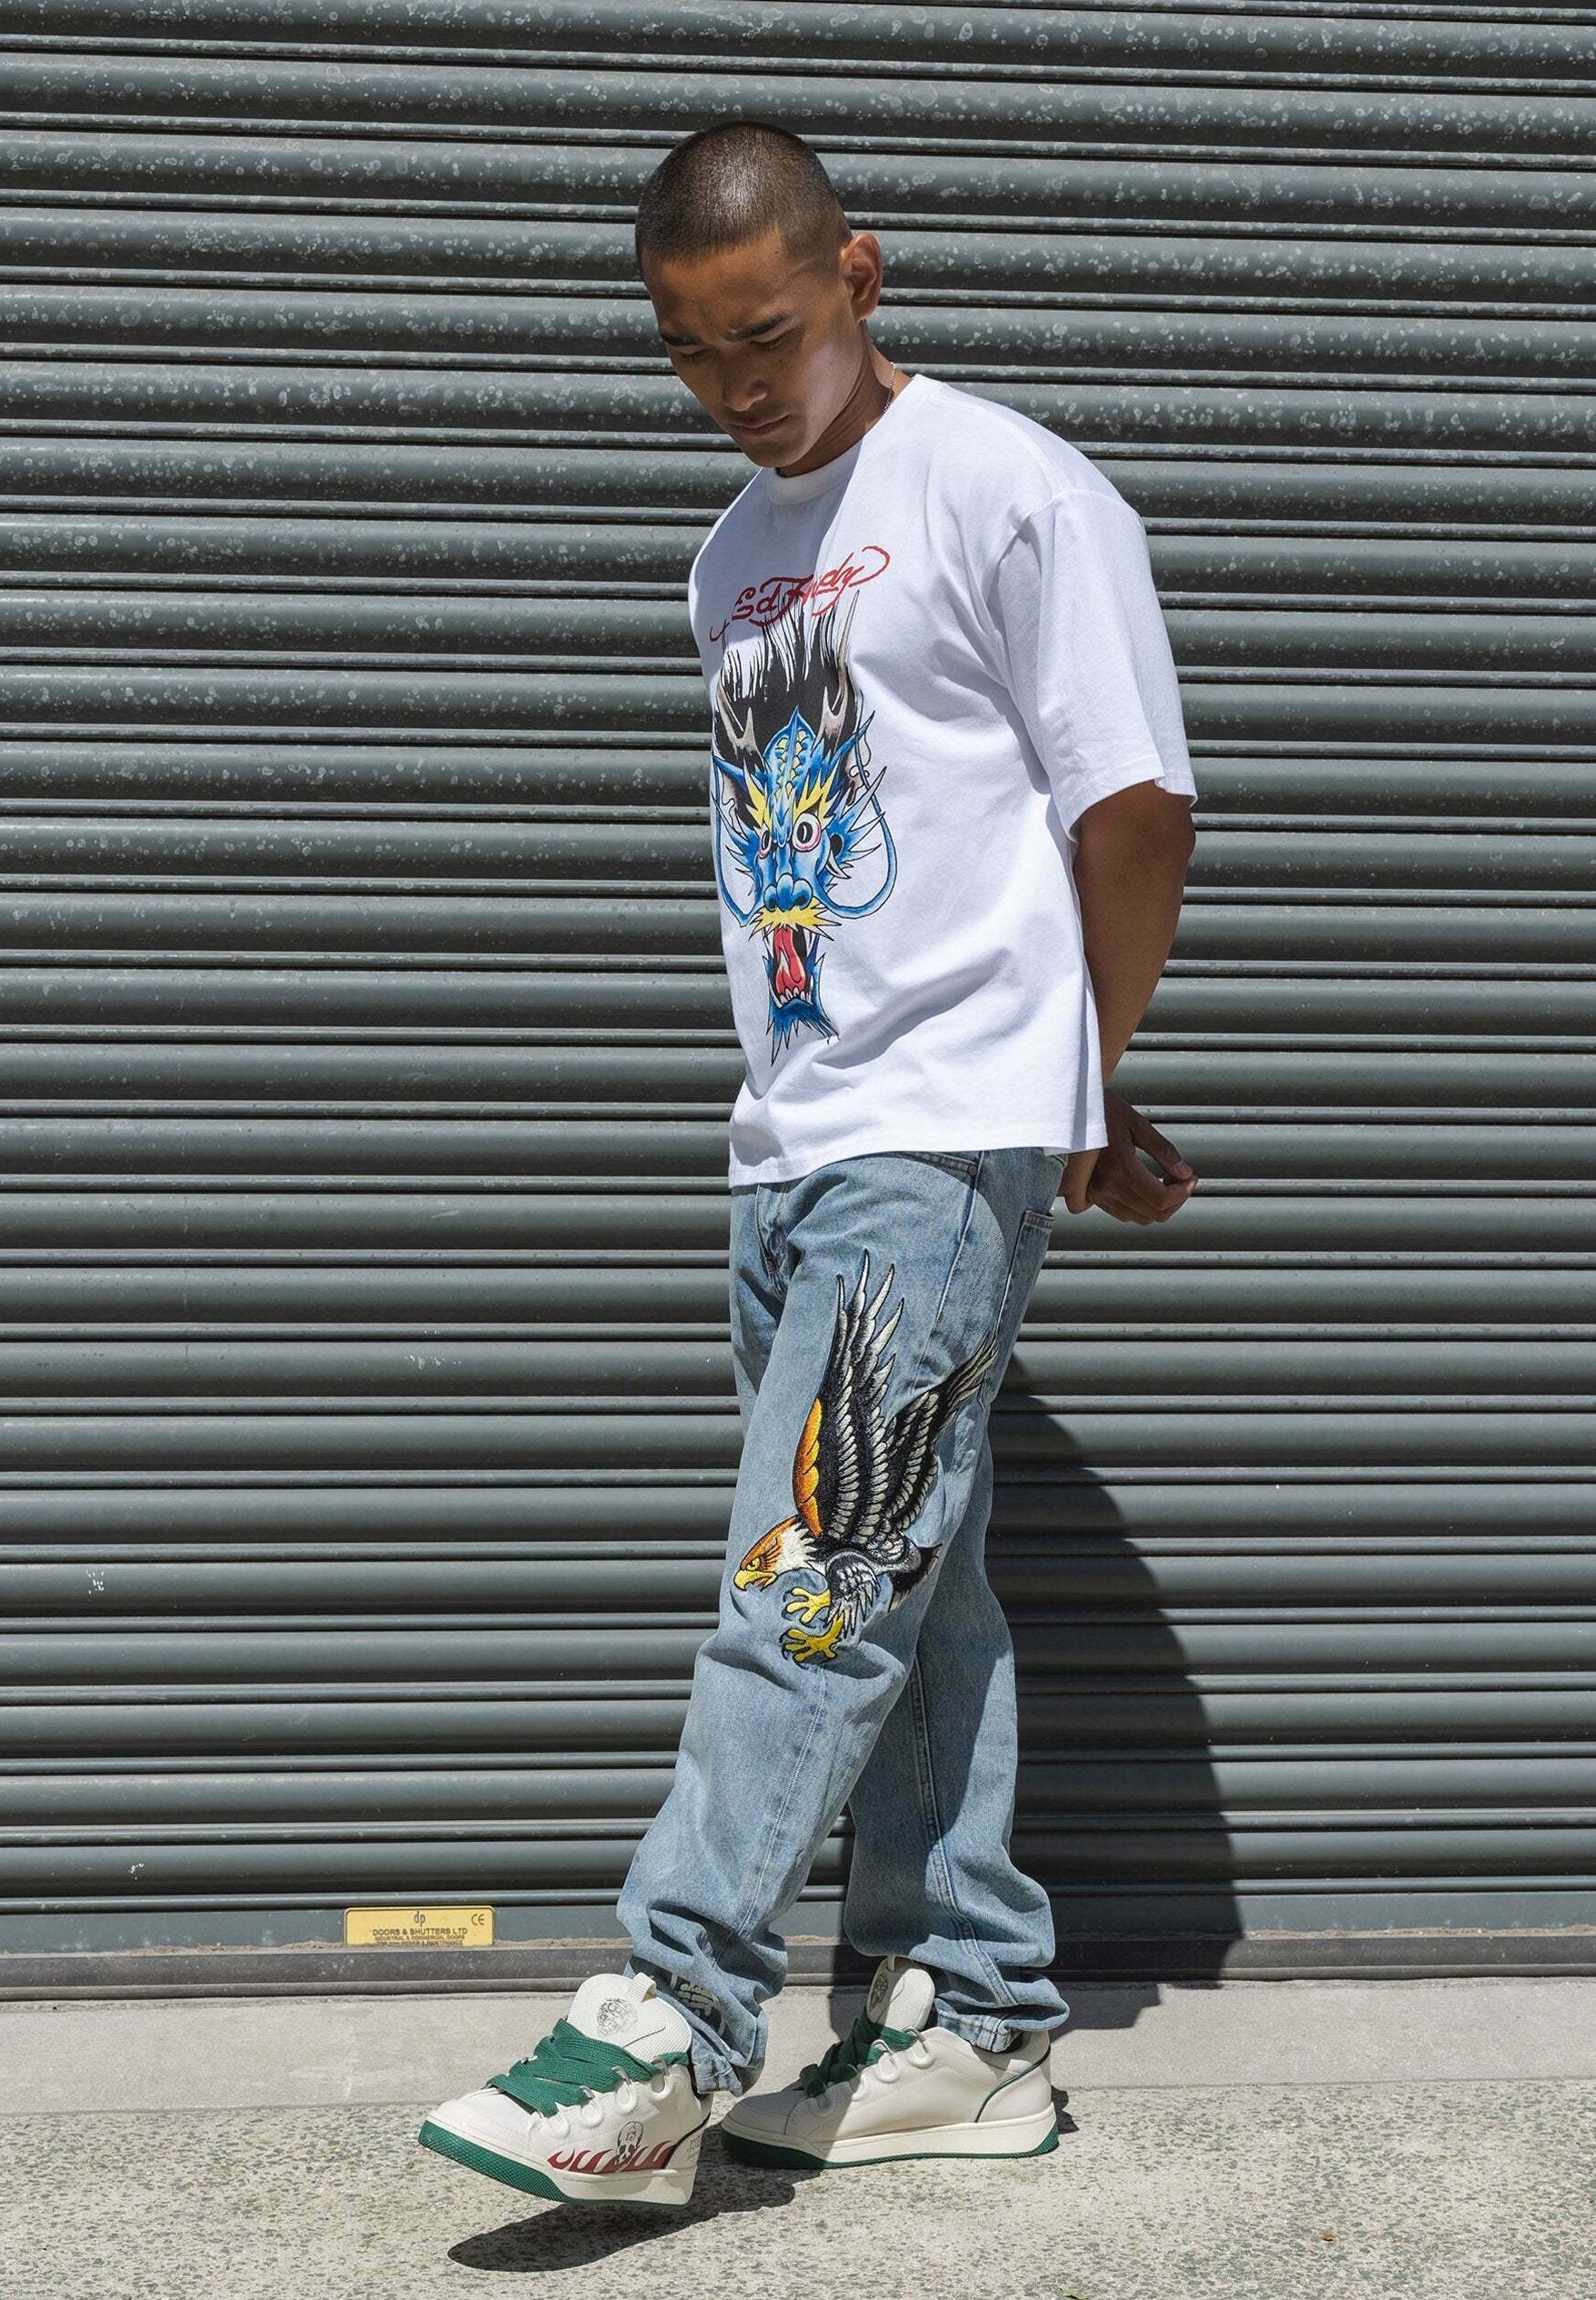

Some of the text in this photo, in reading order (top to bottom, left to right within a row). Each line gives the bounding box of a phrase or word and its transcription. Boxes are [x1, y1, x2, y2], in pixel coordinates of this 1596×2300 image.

[726, 583, 782, 625] Ed
[414, 1911, 425, 1926] dp
[471, 1914, 485, 1925] CE
[409, 1927, 451, 1935] SHUTTERS
